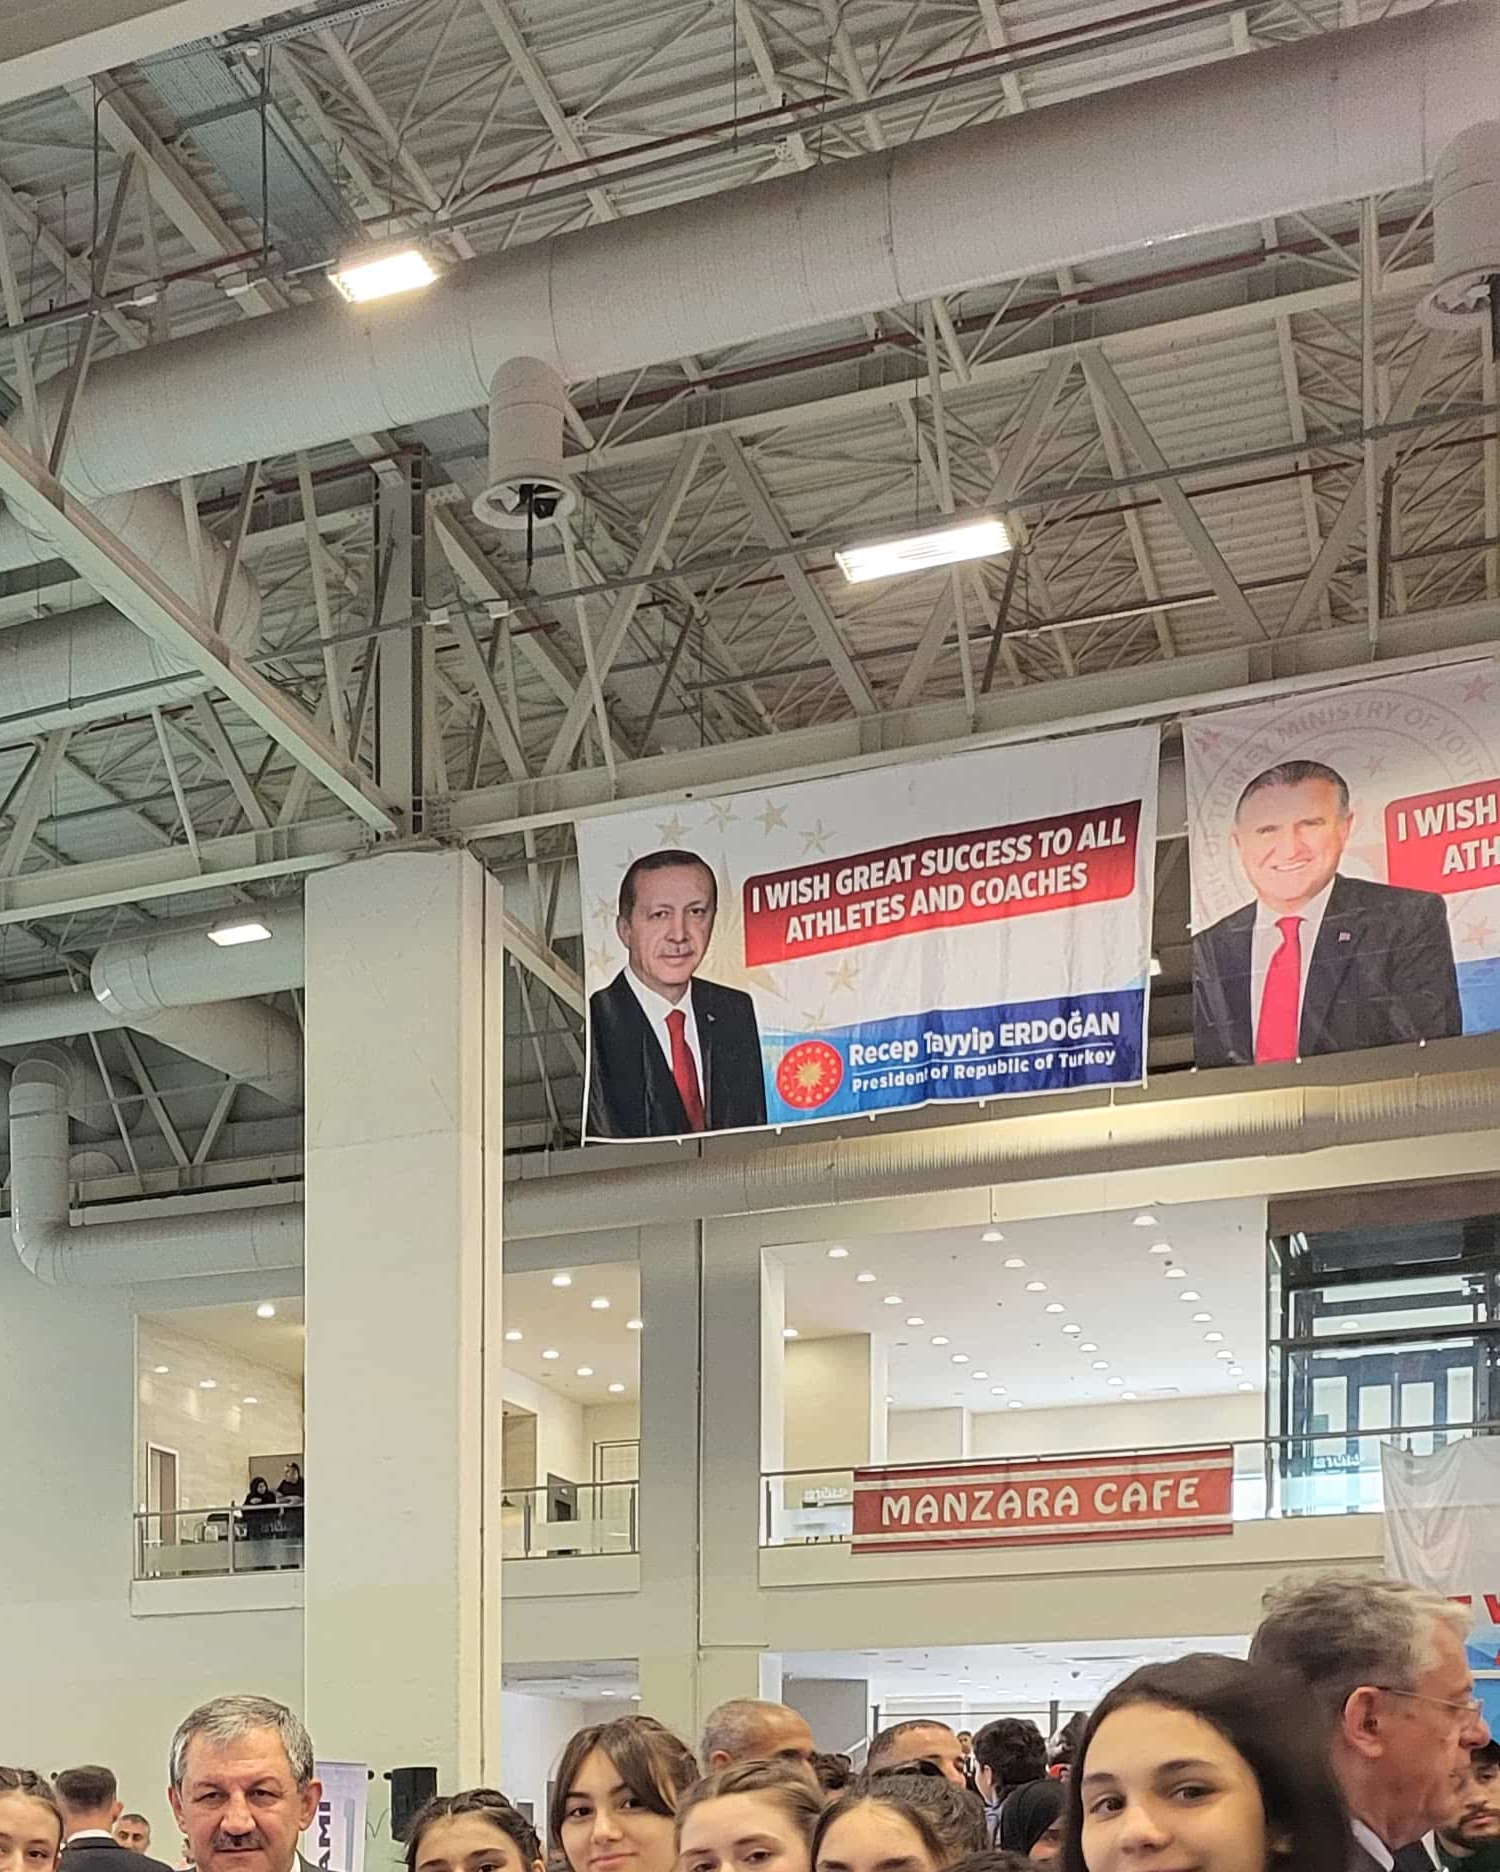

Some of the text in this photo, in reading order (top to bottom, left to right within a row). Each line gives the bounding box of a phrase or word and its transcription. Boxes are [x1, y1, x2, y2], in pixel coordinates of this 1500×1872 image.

[1277, 702, 1400, 744] MINISTRY
[1404, 709, 1441, 732] OF
[1436, 729, 1484, 780] YOUT
[1397, 793, 1497, 842] I WISH
[752, 817, 1126, 913] I WISH GREAT SUCCESS TO ALL
[786, 862, 1088, 944] ATHLETES AND COACHES
[849, 1010, 1120, 1067] Recep Tayyip ERDOĞAN
[931, 1063, 948, 1079] of
[954, 1056, 1030, 1081] Republic
[1034, 1051, 1053, 1071] of
[1058, 1046, 1116, 1068] Turkey
[881, 1477, 1200, 1525] MANZARA CAFE
